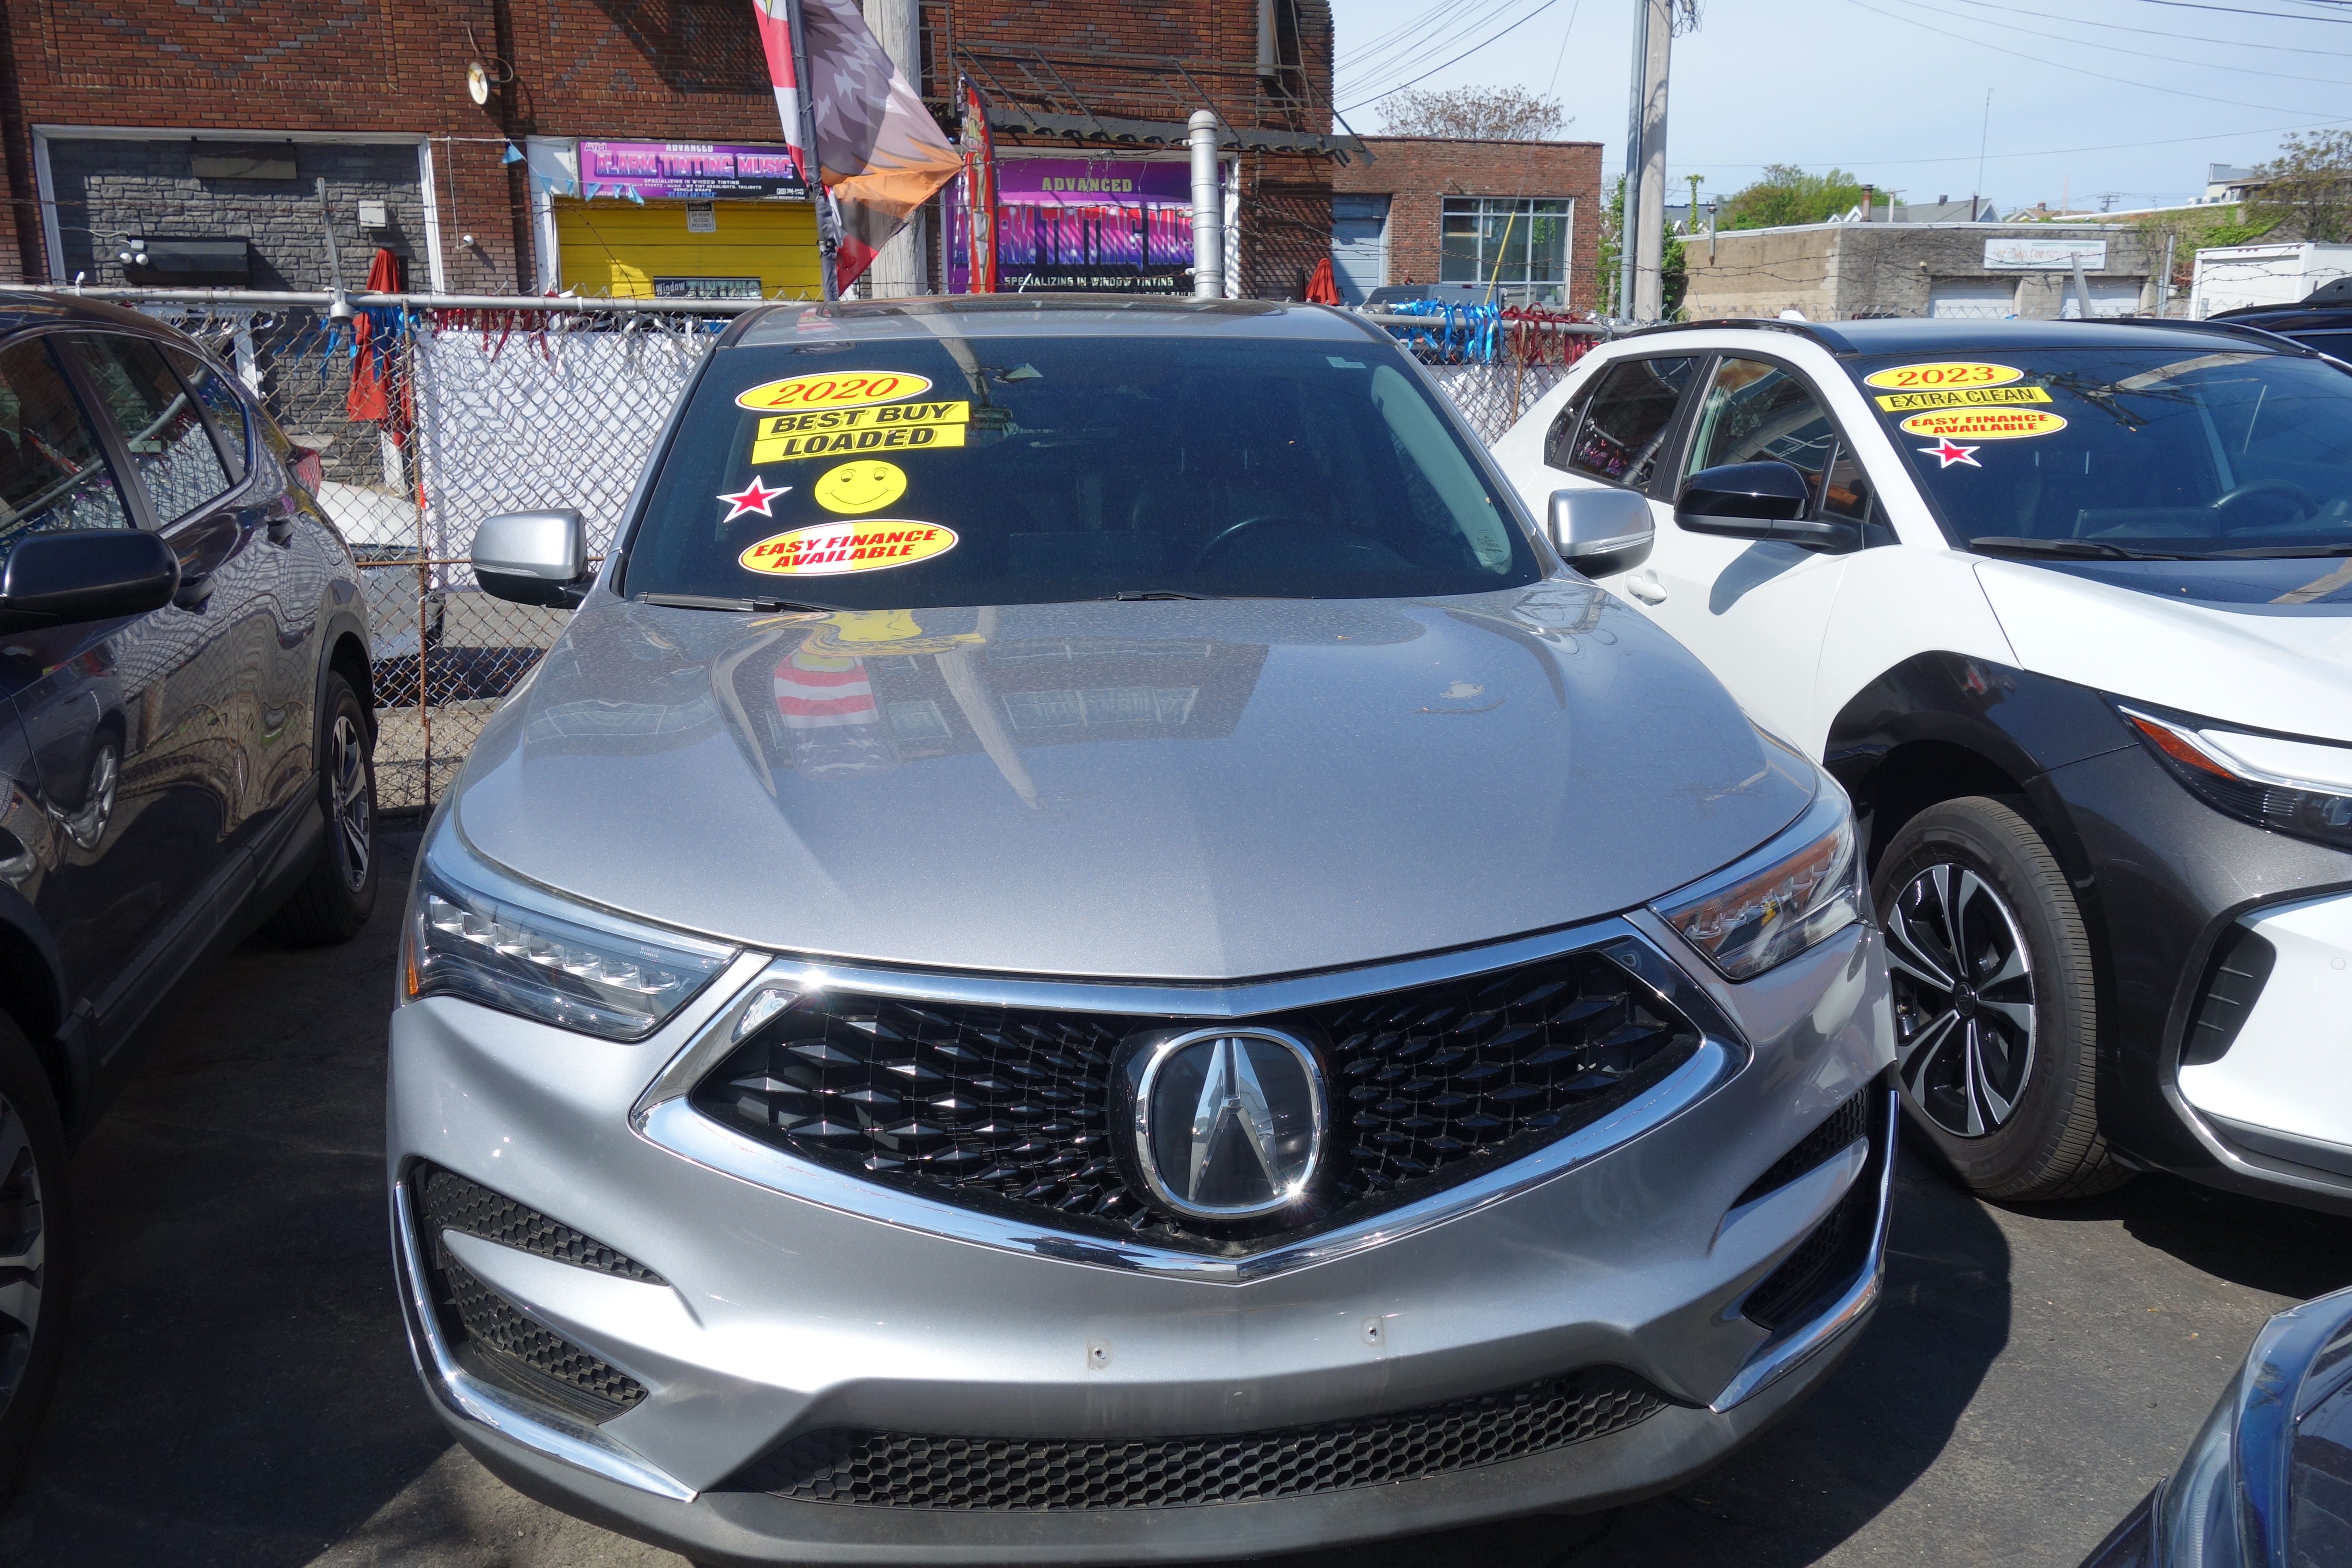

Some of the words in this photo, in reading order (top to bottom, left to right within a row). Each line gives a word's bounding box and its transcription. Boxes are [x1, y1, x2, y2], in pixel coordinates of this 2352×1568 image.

[666, 144, 714, 152] ADVANCED
[596, 152, 657, 175] ALARM
[659, 153, 735, 179] TINTING
[736, 153, 794, 178] MUSIC
[1042, 177, 1133, 193] ADVANCED
[1040, 203, 1143, 271] TINTING
[655, 281, 685, 295] Window
[686, 280, 760, 297] TINTING
[1077, 277, 1087, 286] IN
[1091, 277, 1132, 287] WINDOW
[1136, 277, 1173, 287] TINTING
[1896, 367, 1994, 386] 2023
[767, 377, 899, 406] 2020
[1889, 392, 1966, 409] EXTRA
[1966, 388, 2037, 403] CLEAN
[770, 410, 868, 435] BEST
[875, 403, 959, 424] BUY
[1911, 416, 1960, 427] EASY
[1966, 414, 2049, 424] FINANCE
[1932, 423, 2038, 434] AVAILABLE
[782, 426, 938, 458] LOADED
[753, 538, 822, 557] EASY
[826, 529, 939, 548] FINANCE
[772, 544, 914, 569] AVAILABLE
